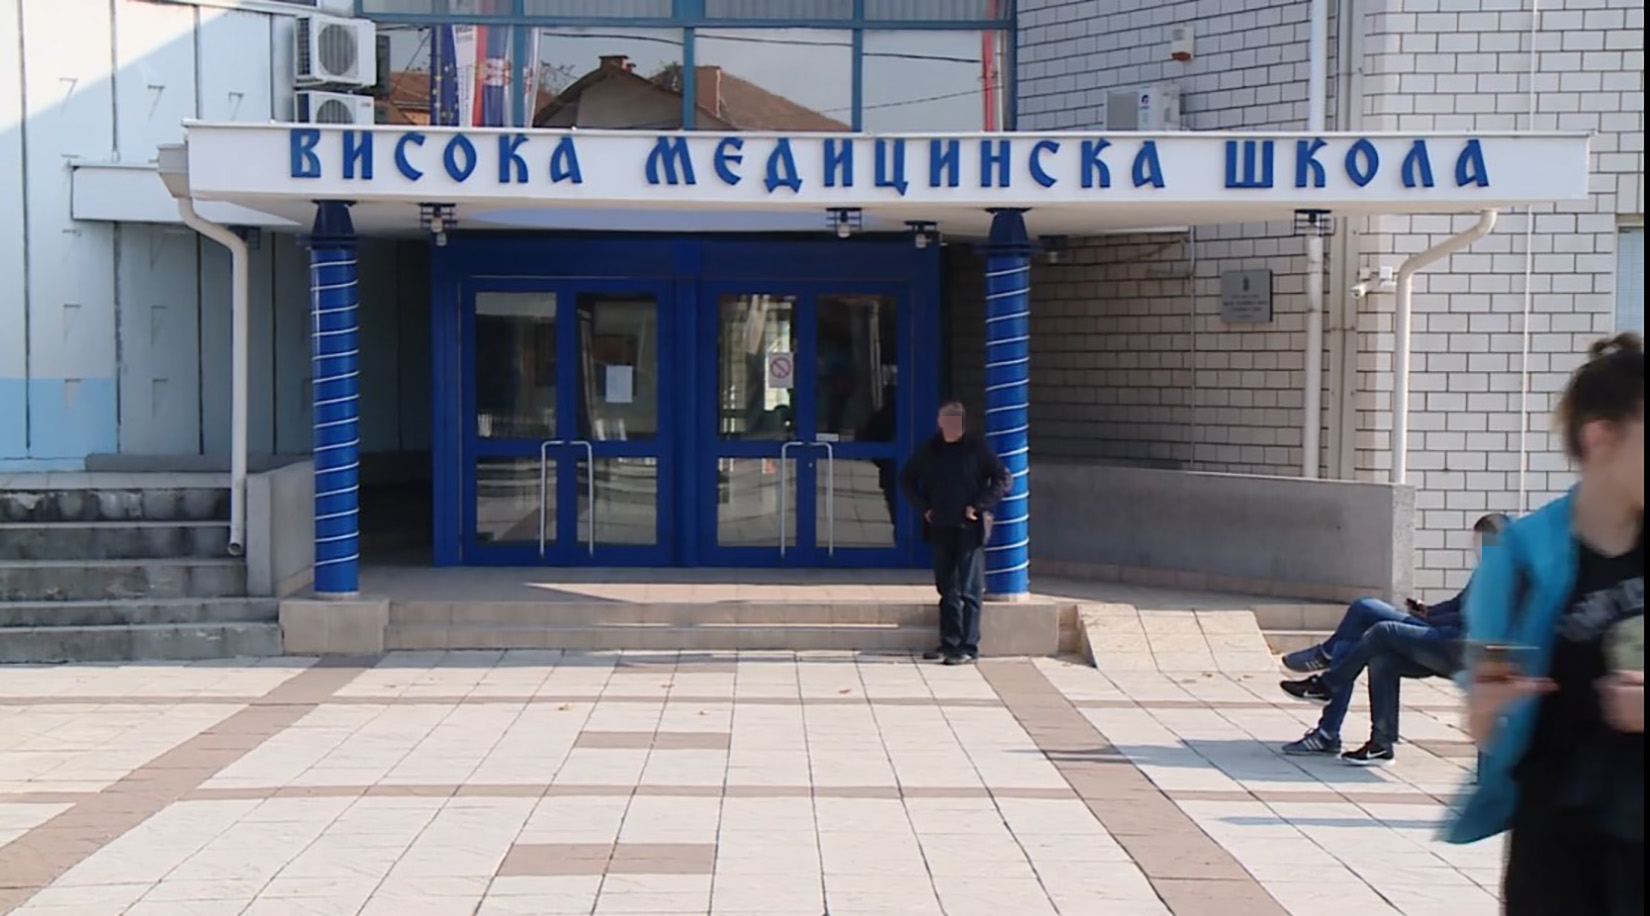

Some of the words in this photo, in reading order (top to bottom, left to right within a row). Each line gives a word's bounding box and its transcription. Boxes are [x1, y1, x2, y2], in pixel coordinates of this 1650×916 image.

[290, 128, 583, 184] ВИСОКА
[645, 136, 1165, 195] МЕДИЦИНСКА
[1225, 137, 1491, 190] ШКОЛА
